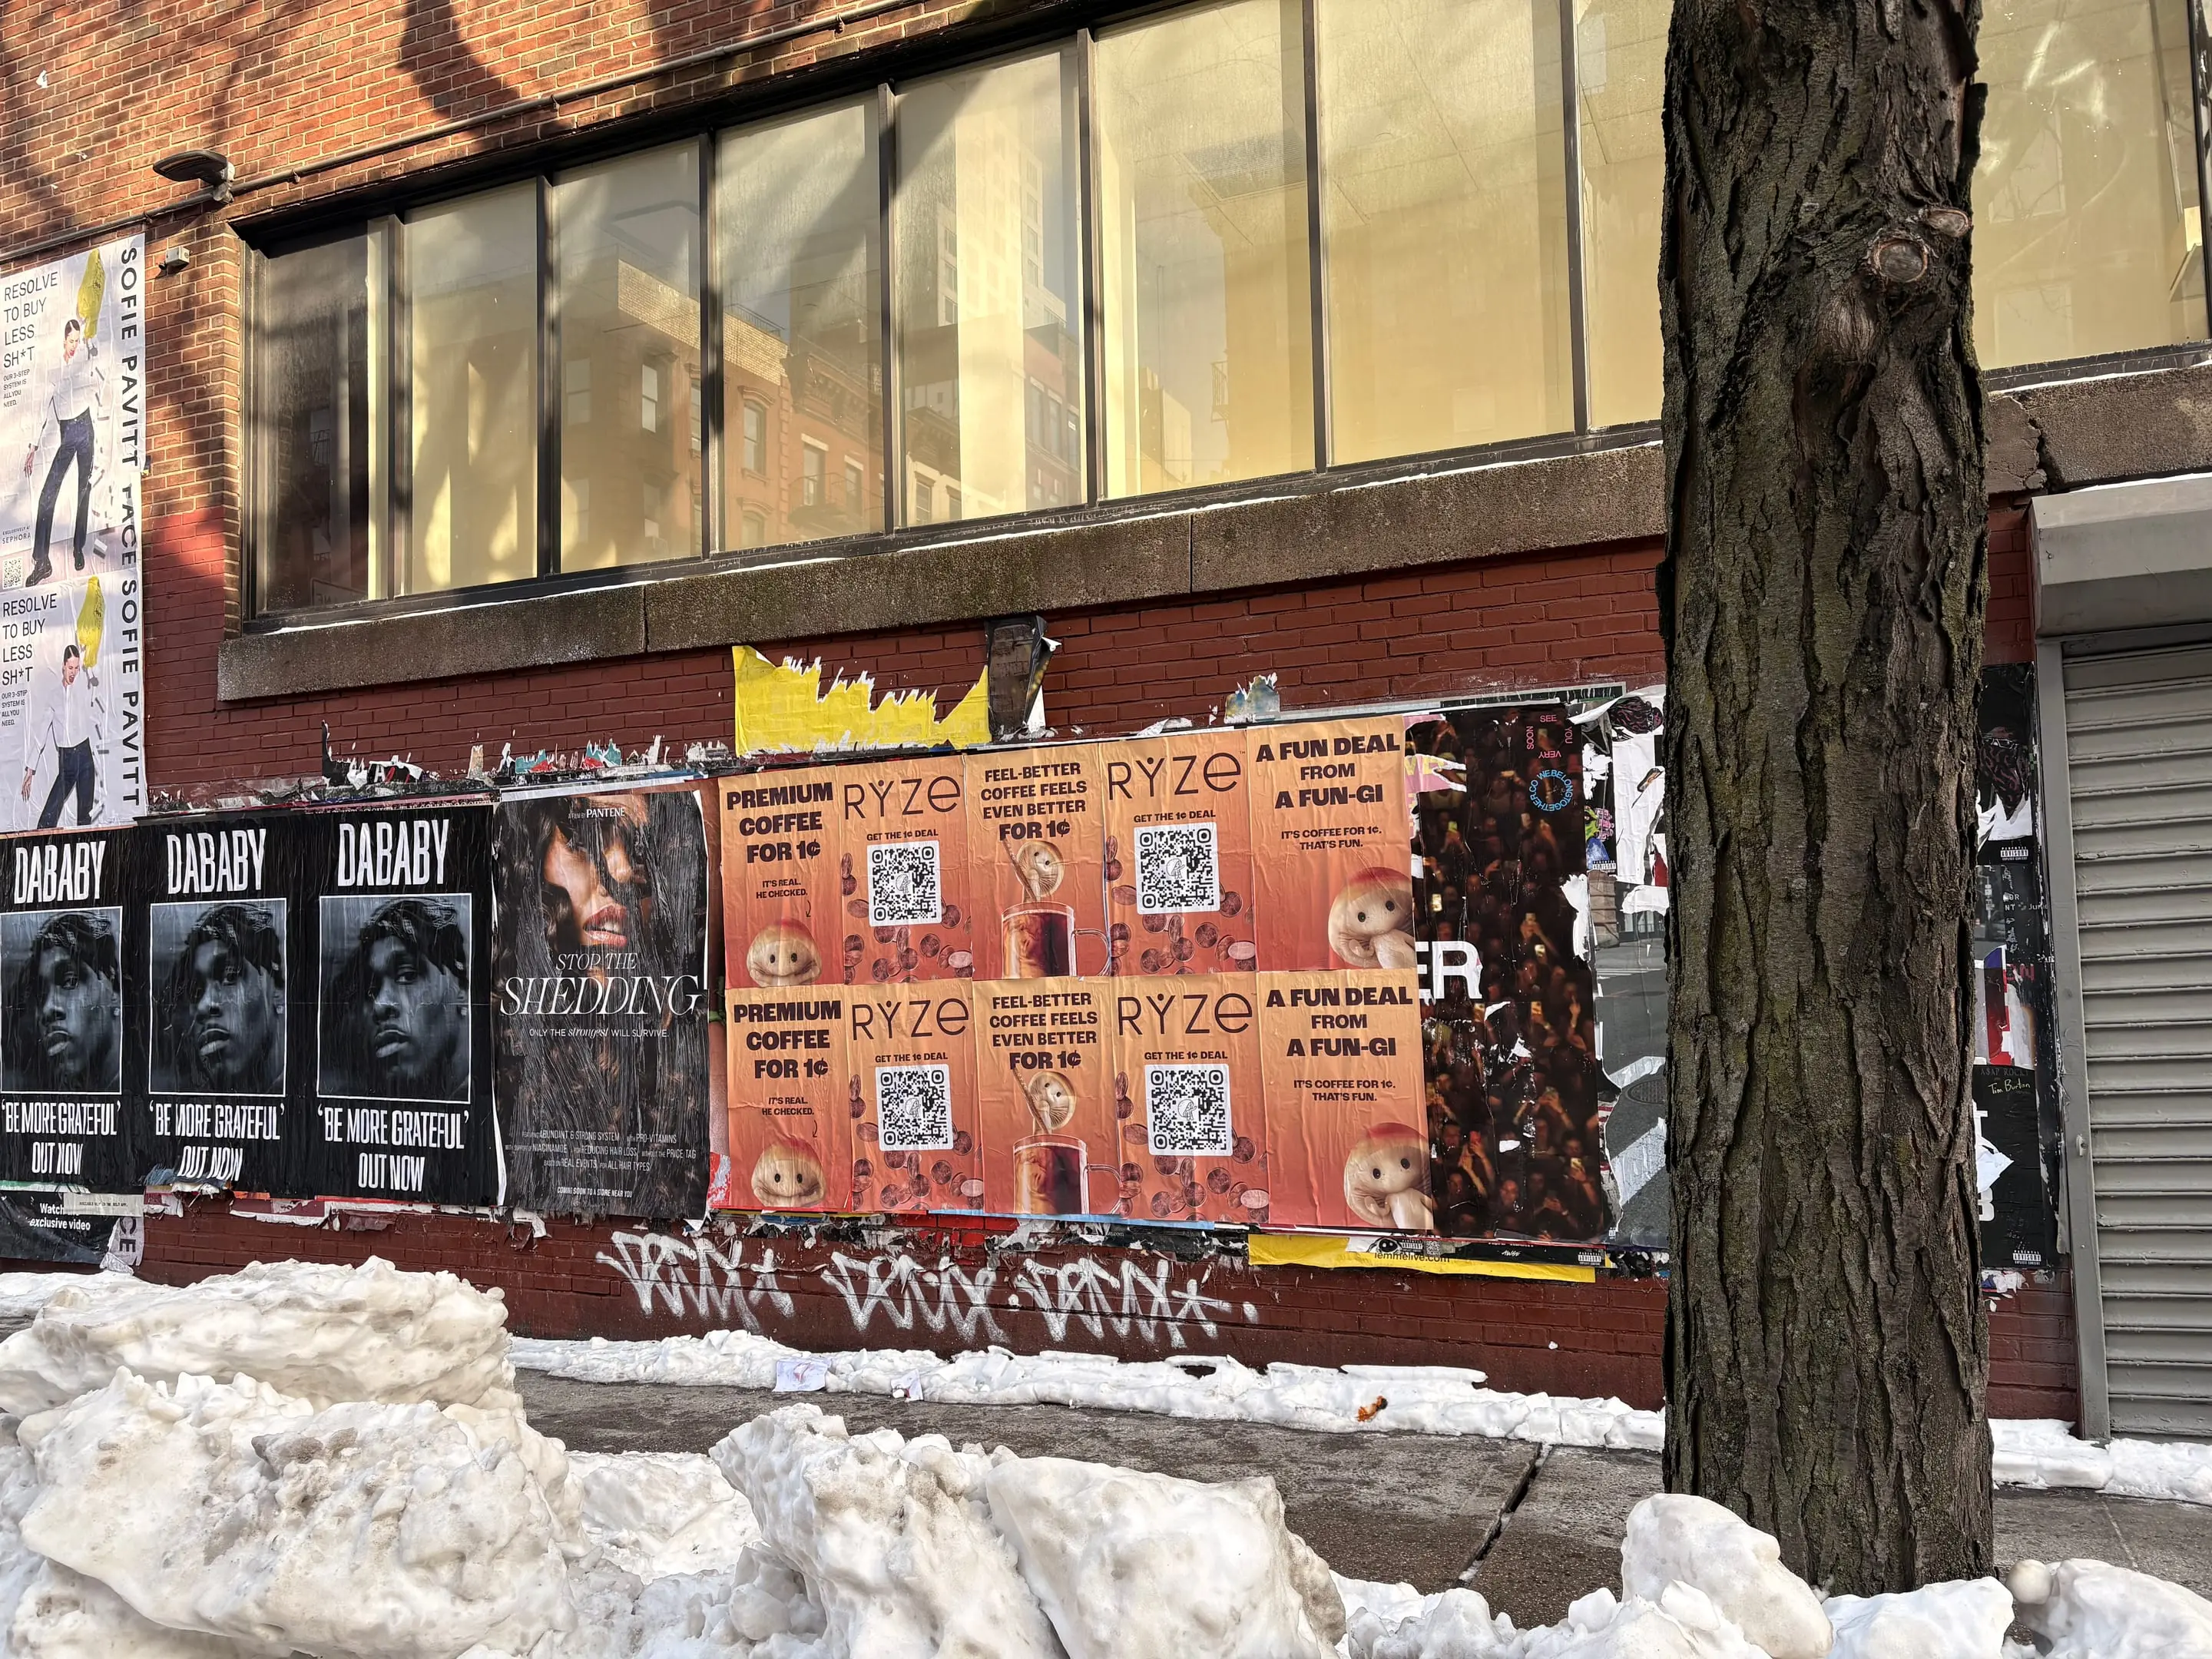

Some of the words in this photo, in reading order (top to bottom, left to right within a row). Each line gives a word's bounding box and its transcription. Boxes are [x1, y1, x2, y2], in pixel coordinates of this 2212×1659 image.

[5, 271, 58, 301] RESOLVE
[121, 247, 137, 340] SOFIE
[4, 306, 18, 323] TO
[24, 296, 46, 317] BUY
[5, 324, 35, 346] LESS
[121, 355, 139, 467] PAVITT
[2, 533, 31, 544] SEPHORA
[3, 593, 57, 618] RESOLVE
[2, 624, 18, 640] TO
[23, 618, 45, 636] BUY
[121, 579, 137, 674] SOFIE
[3, 644, 32, 663] LESS
[1256, 744, 1275, 763] A
[1280, 739, 1328, 760] FUN
[1333, 733, 1401, 756] DEAL
[1526, 726, 1535, 750] SOON
[122, 691, 139, 806] PAVITT
[1538, 750, 1561, 759] VERY
[985, 762, 1081, 783] FEEL-BETTER
[1300, 764, 1356, 781] FROM
[727, 782, 833, 811] PREMIUM
[980, 784, 1038, 802] COFFEE
[1041, 781, 1088, 796] FEELS
[1275, 790, 1293, 810] A
[1299, 784, 1383, 807] FUN-GI
[586, 807, 625, 818] PANTENE
[983, 804, 1024, 820] EVEN
[1027, 800, 1087, 815] BETTER
[1133, 813, 1153, 823] GET
[1155, 812, 1173, 822] THE
[1188, 810, 1216, 820] DEAL
[739, 812, 823, 837] COFFEE
[998, 822, 1043, 840] FOR
[1045, 819, 1071, 838] 1¢
[1281, 829, 1300, 839] IT'S
[1302, 827, 1341, 839] COFFEE
[1343, 826, 1364, 836] FOR
[866, 832, 884, 842] GET
[886, 830, 902, 840] THE
[914, 828, 939, 839] DEAL
[1299, 839, 1336, 850] THAT'S
[1338, 838, 1363, 849] FUN.
[166, 828, 267, 895] DABABY
[337, 820, 449, 887] DABABY
[747, 843, 792, 864] FOR
[795, 839, 821, 860] 1¢
[14, 840, 106, 904] DABABY
[780, 878, 802, 888] REAL.
[756, 890, 766, 899] HE
[767, 888, 809, 899] CHECKED.
[555, 953, 601, 971] STOP
[601, 952, 637, 969] THE
[500, 975, 702, 1016] SHEDDING
[992, 992, 1091, 1010] FEEL-BETTER
[1266, 989, 1286, 1008] A
[1290, 988, 1341, 1007] FUN
[1345, 986, 1413, 1005] DEAL
[733, 1000, 842, 1023] PREMIUM
[989, 1014, 1048, 1028] COFFEE
[1050, 1011, 1098, 1026] FEELS
[529, 1028, 547, 1037] ONLY
[550, 1028, 566, 1037] THE
[568, 1027, 609, 1038] strongest
[632, 1029, 669, 1038] SURVIVE.
[1311, 1015, 1368, 1030] FROM
[746, 1029, 830, 1051] COFFEE
[992, 1033, 1035, 1047] EVEN
[1037, 1031, 1097, 1045] BETTER
[1286, 1038, 1306, 1057] A
[1310, 1038, 1397, 1057] FUN-GI
[875, 1053, 892, 1063] GET
[893, 1053, 911, 1062] THE
[923, 1052, 949, 1061] DEAL
[1009, 1051, 1054, 1070] FOR
[1057, 1050, 1082, 1070] 1¢
[1144, 1051, 1163, 1061] GET
[1165, 1051, 1184, 1060] THE
[1200, 1050, 1228, 1059] DEAL
[754, 1059, 800, 1079] FOR
[803, 1057, 830, 1078] 1¢
[1293, 1080, 1313, 1089] IT'S
[1314, 1079, 1355, 1089] COFFEE
[1356, 1079, 1379, 1089] FOR
[1988, 1083, 2003, 1094] Tim
[2004, 1078, 2031, 1092] Burton
[785, 1096, 809, 1105] REAL.
[1312, 1091, 1349, 1102] THAT'S
[1351, 1091, 1377, 1101] FUN.
[22, 1102, 56, 1134] MORE
[175, 1103, 211, 1137] MORE
[773, 1107, 815, 1116] CHECKED.
[346, 1108, 388, 1144] MORE
[540, 1130, 568, 1139] ABUNDANT
[575, 1131, 597, 1141] STRONG
[598, 1131, 620, 1141] SYSTEM
[636, 1134, 677, 1144] PRO-VITAMINS
[31, 1141, 55, 1174] OUT
[56, 1142, 83, 1175] NOW
[177, 1145, 208, 1177] OUT
[209, 1146, 243, 1181] NOW
[610, 1147, 623, 1156] HAIR
[667, 1149, 684, 1158] PRICE
[685, 1149, 697, 1159] TAG
[358, 1152, 387, 1188] OUT
[389, 1154, 425, 1192] NOW
[561, 1157, 575, 1167] REAL
[575, 1158, 597, 1168] EVENTS
[608, 1161, 618, 1169] ALL
[619, 1161, 631, 1170] HAIR
[633, 1161, 650, 1171] TYPES
[40, 1203, 64, 1215] Watch
[29, 1217, 67, 1229] exclusive
[69, 1219, 91, 1230] video
